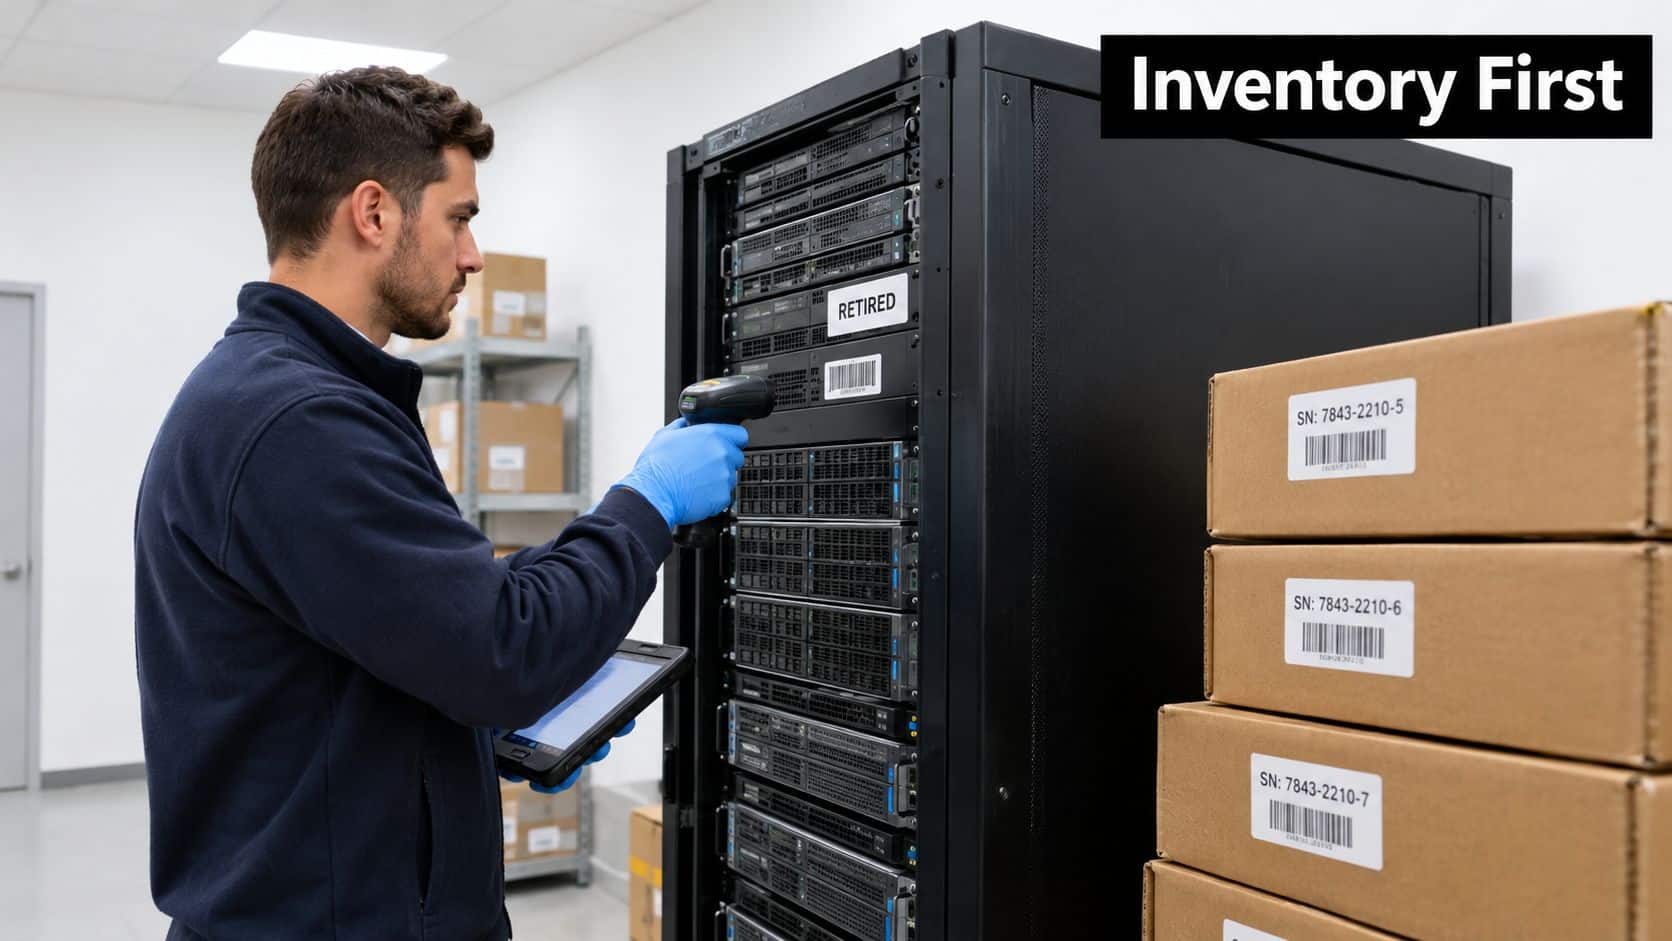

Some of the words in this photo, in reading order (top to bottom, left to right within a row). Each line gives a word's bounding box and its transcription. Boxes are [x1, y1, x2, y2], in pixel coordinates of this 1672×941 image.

[838, 292, 896, 321] RETIRED
[1297, 410, 1318, 426] SN:
[1322, 398, 1404, 423] 7843-2210-5
[1294, 595, 1315, 611] SN:
[1319, 596, 1402, 616] 7843-2210-6
[1259, 771, 1281, 790] SN:
[1285, 776, 1369, 807] 7843-2210-7
